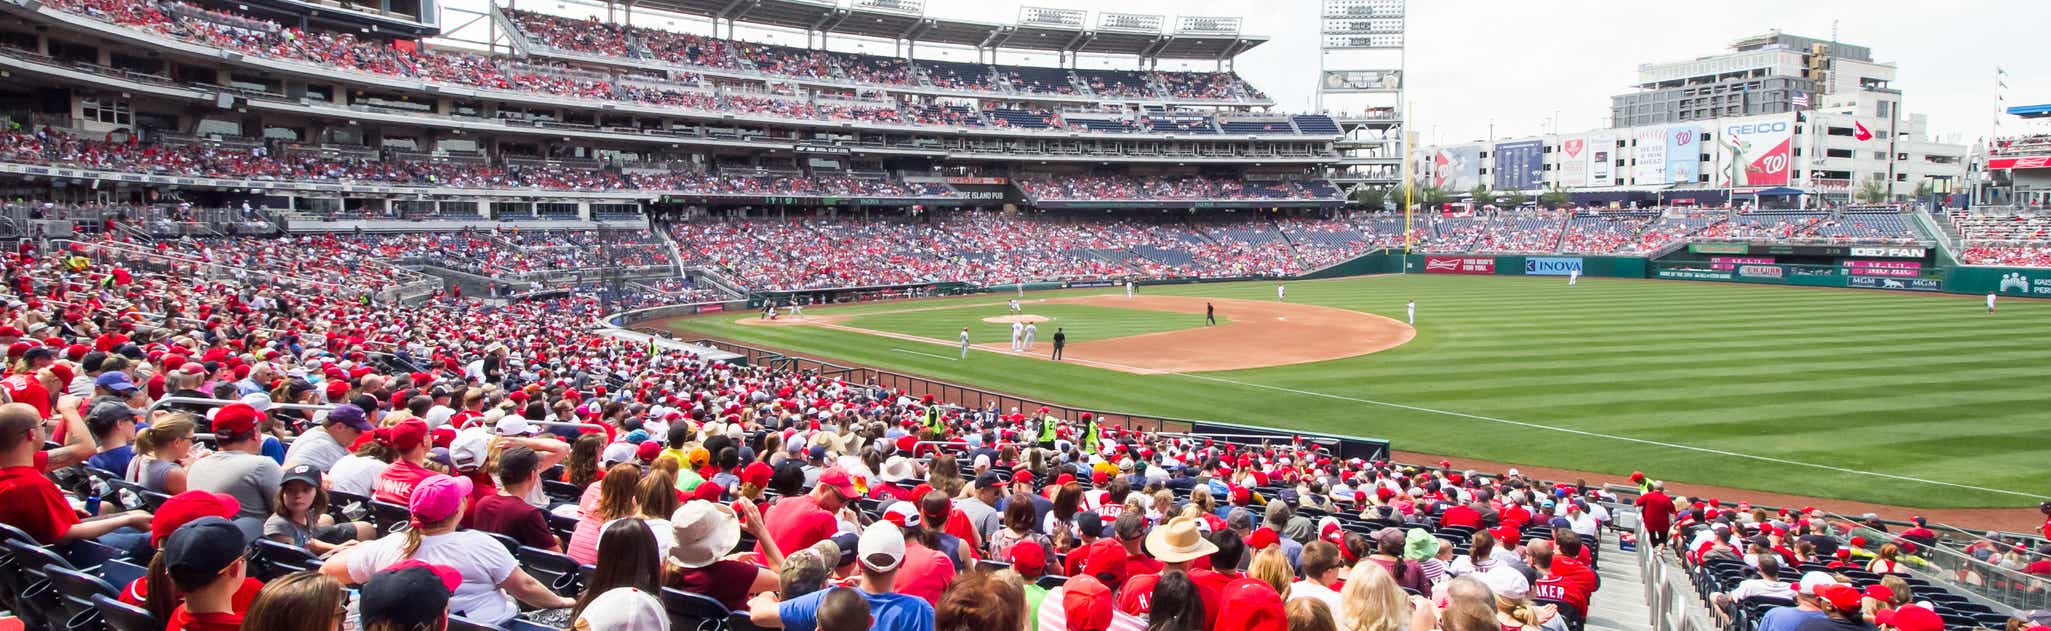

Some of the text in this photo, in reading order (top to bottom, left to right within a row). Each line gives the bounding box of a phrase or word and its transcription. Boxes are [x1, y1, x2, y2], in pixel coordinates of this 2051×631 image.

[1728, 122, 1786, 135] GEICO
[1763, 153, 1787, 174] W
[161, 191, 184, 201] PNC
[1889, 248, 1925, 257] FAN
[1540, 262, 1581, 271] INOVA
[1535, 583, 1565, 600] AKER
